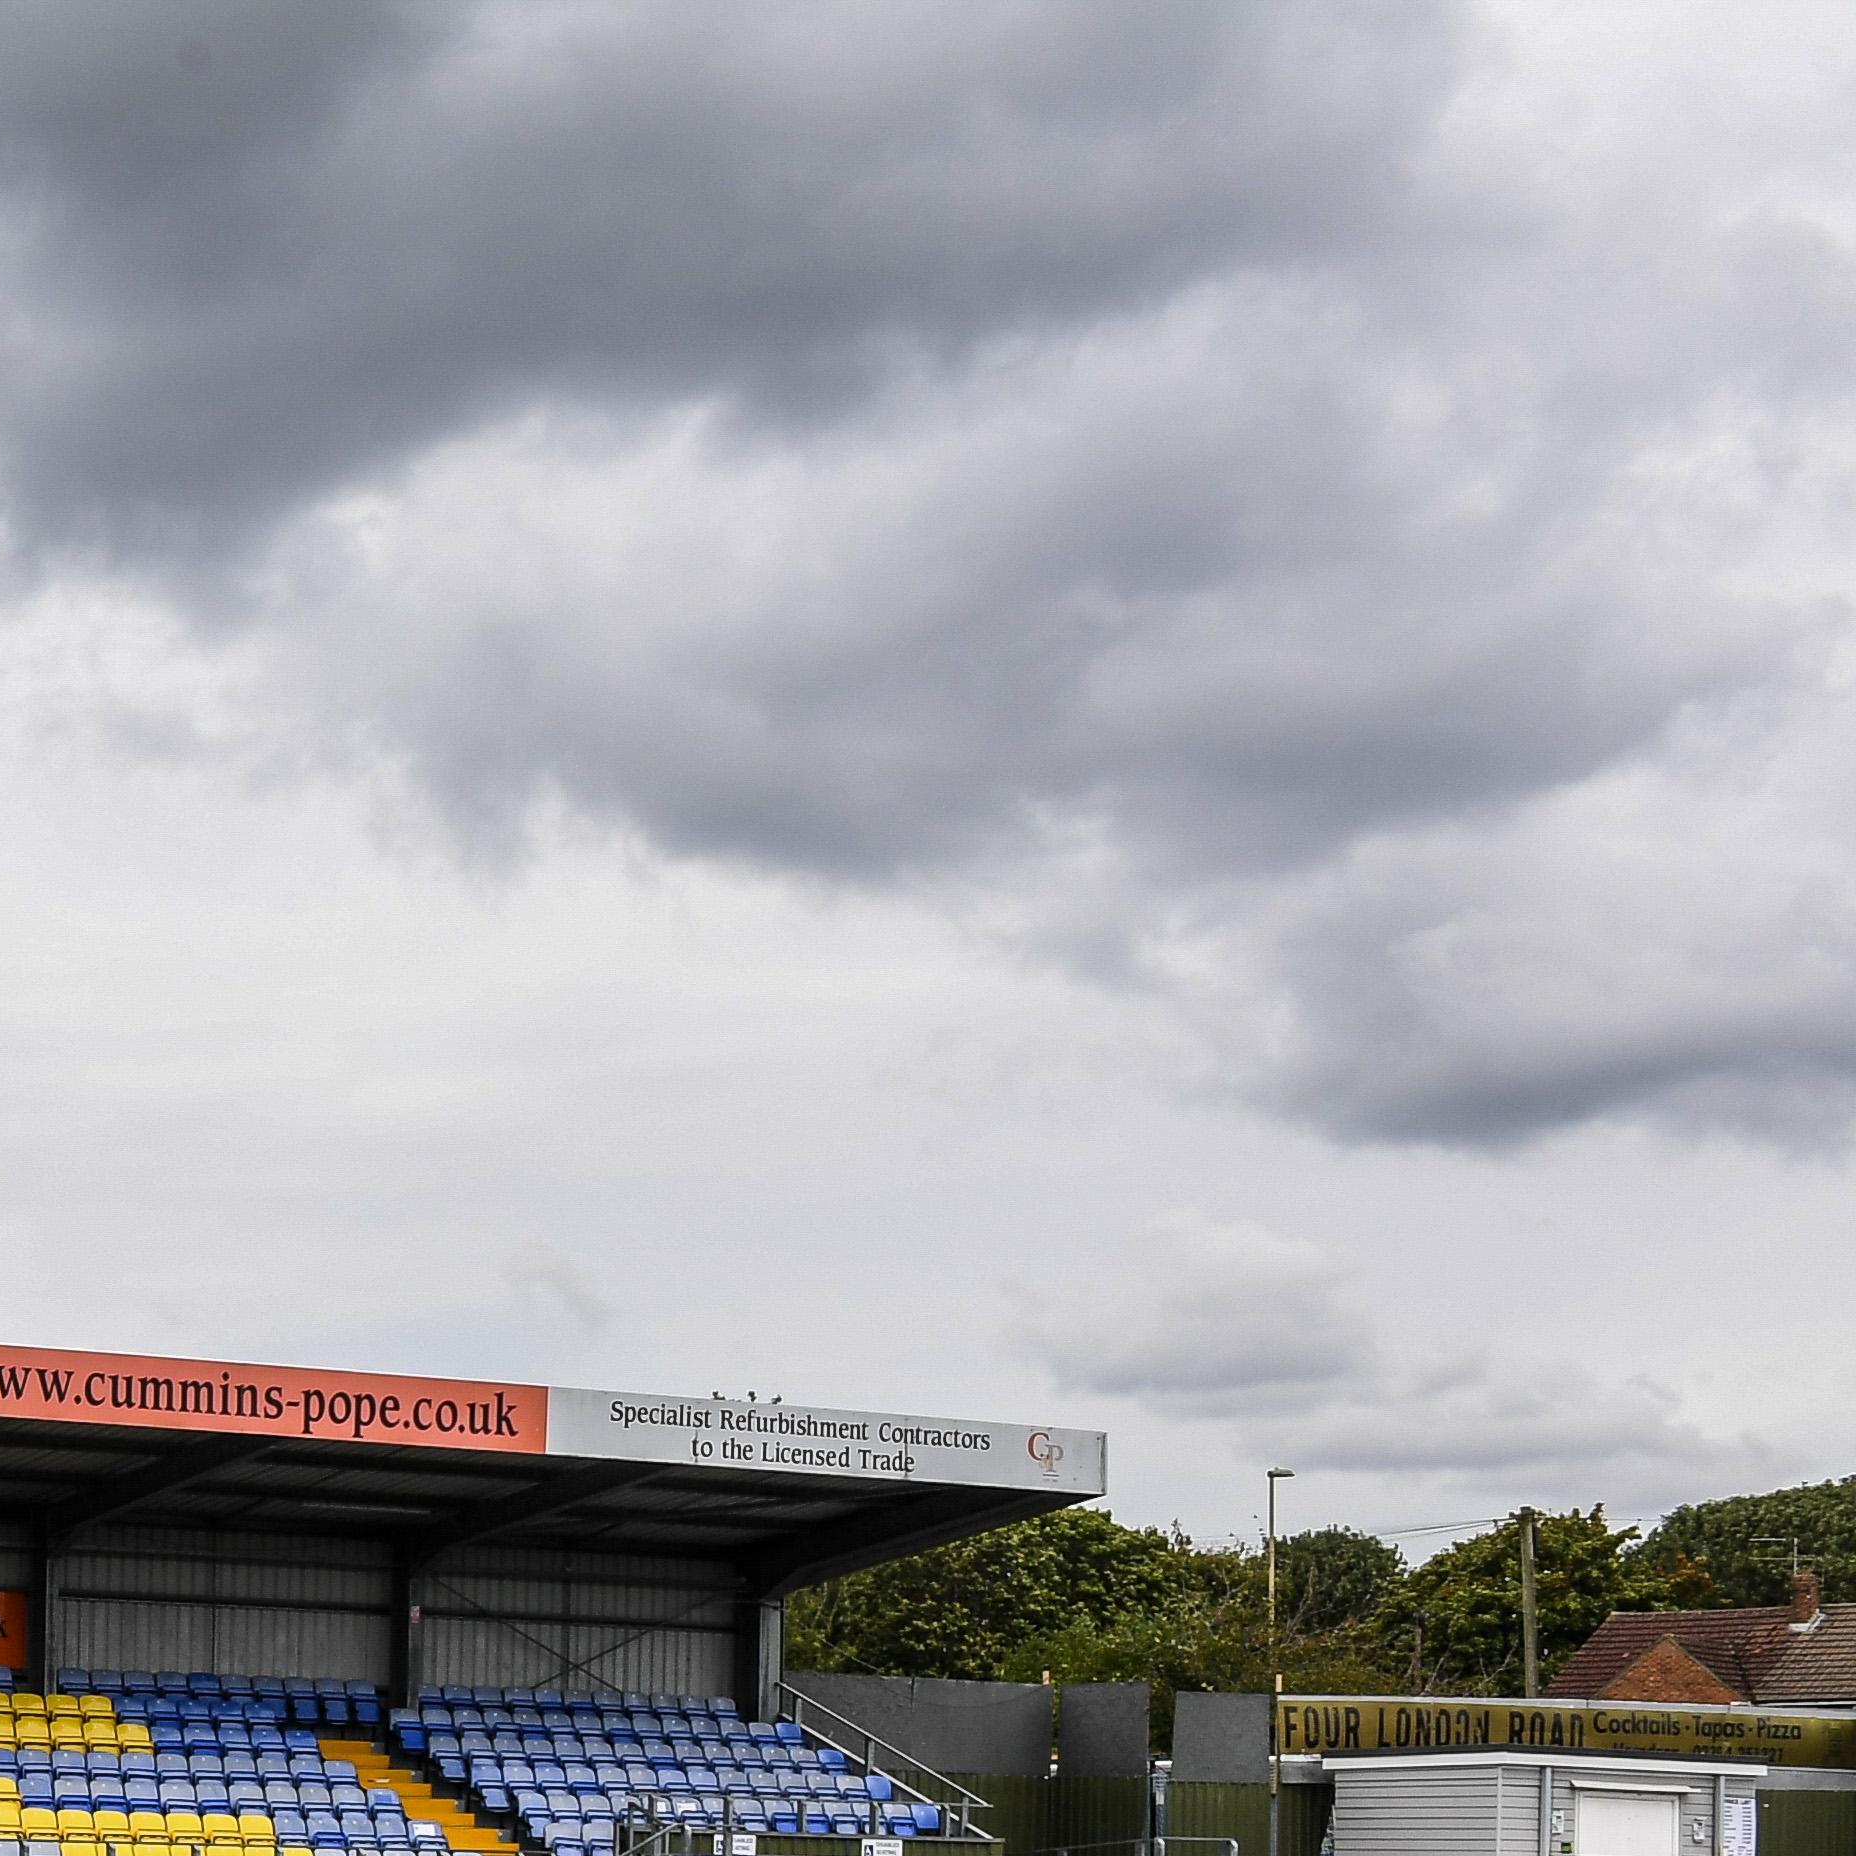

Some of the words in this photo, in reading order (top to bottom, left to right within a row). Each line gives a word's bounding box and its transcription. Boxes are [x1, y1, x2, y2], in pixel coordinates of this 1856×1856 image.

[609, 1401, 712, 1430] Specialist
[719, 1409, 870, 1442] Refurbishment
[878, 1422, 991, 1451] Contractors
[691, 1437, 714, 1458] to
[721, 1437, 754, 1462] the
[761, 1441, 851, 1470] Licensed
[857, 1447, 916, 1474] Trade
[1285, 1706, 1360, 1749] FOUR
[1377, 1707, 1490, 1748] LONDON
[1508, 1711, 1585, 1748] ROAD
[1592, 1711, 1681, 1737] Cocktails
[1691, 1715, 1745, 1742] Tapas
[1756, 1717, 1803, 1740] Pizza
